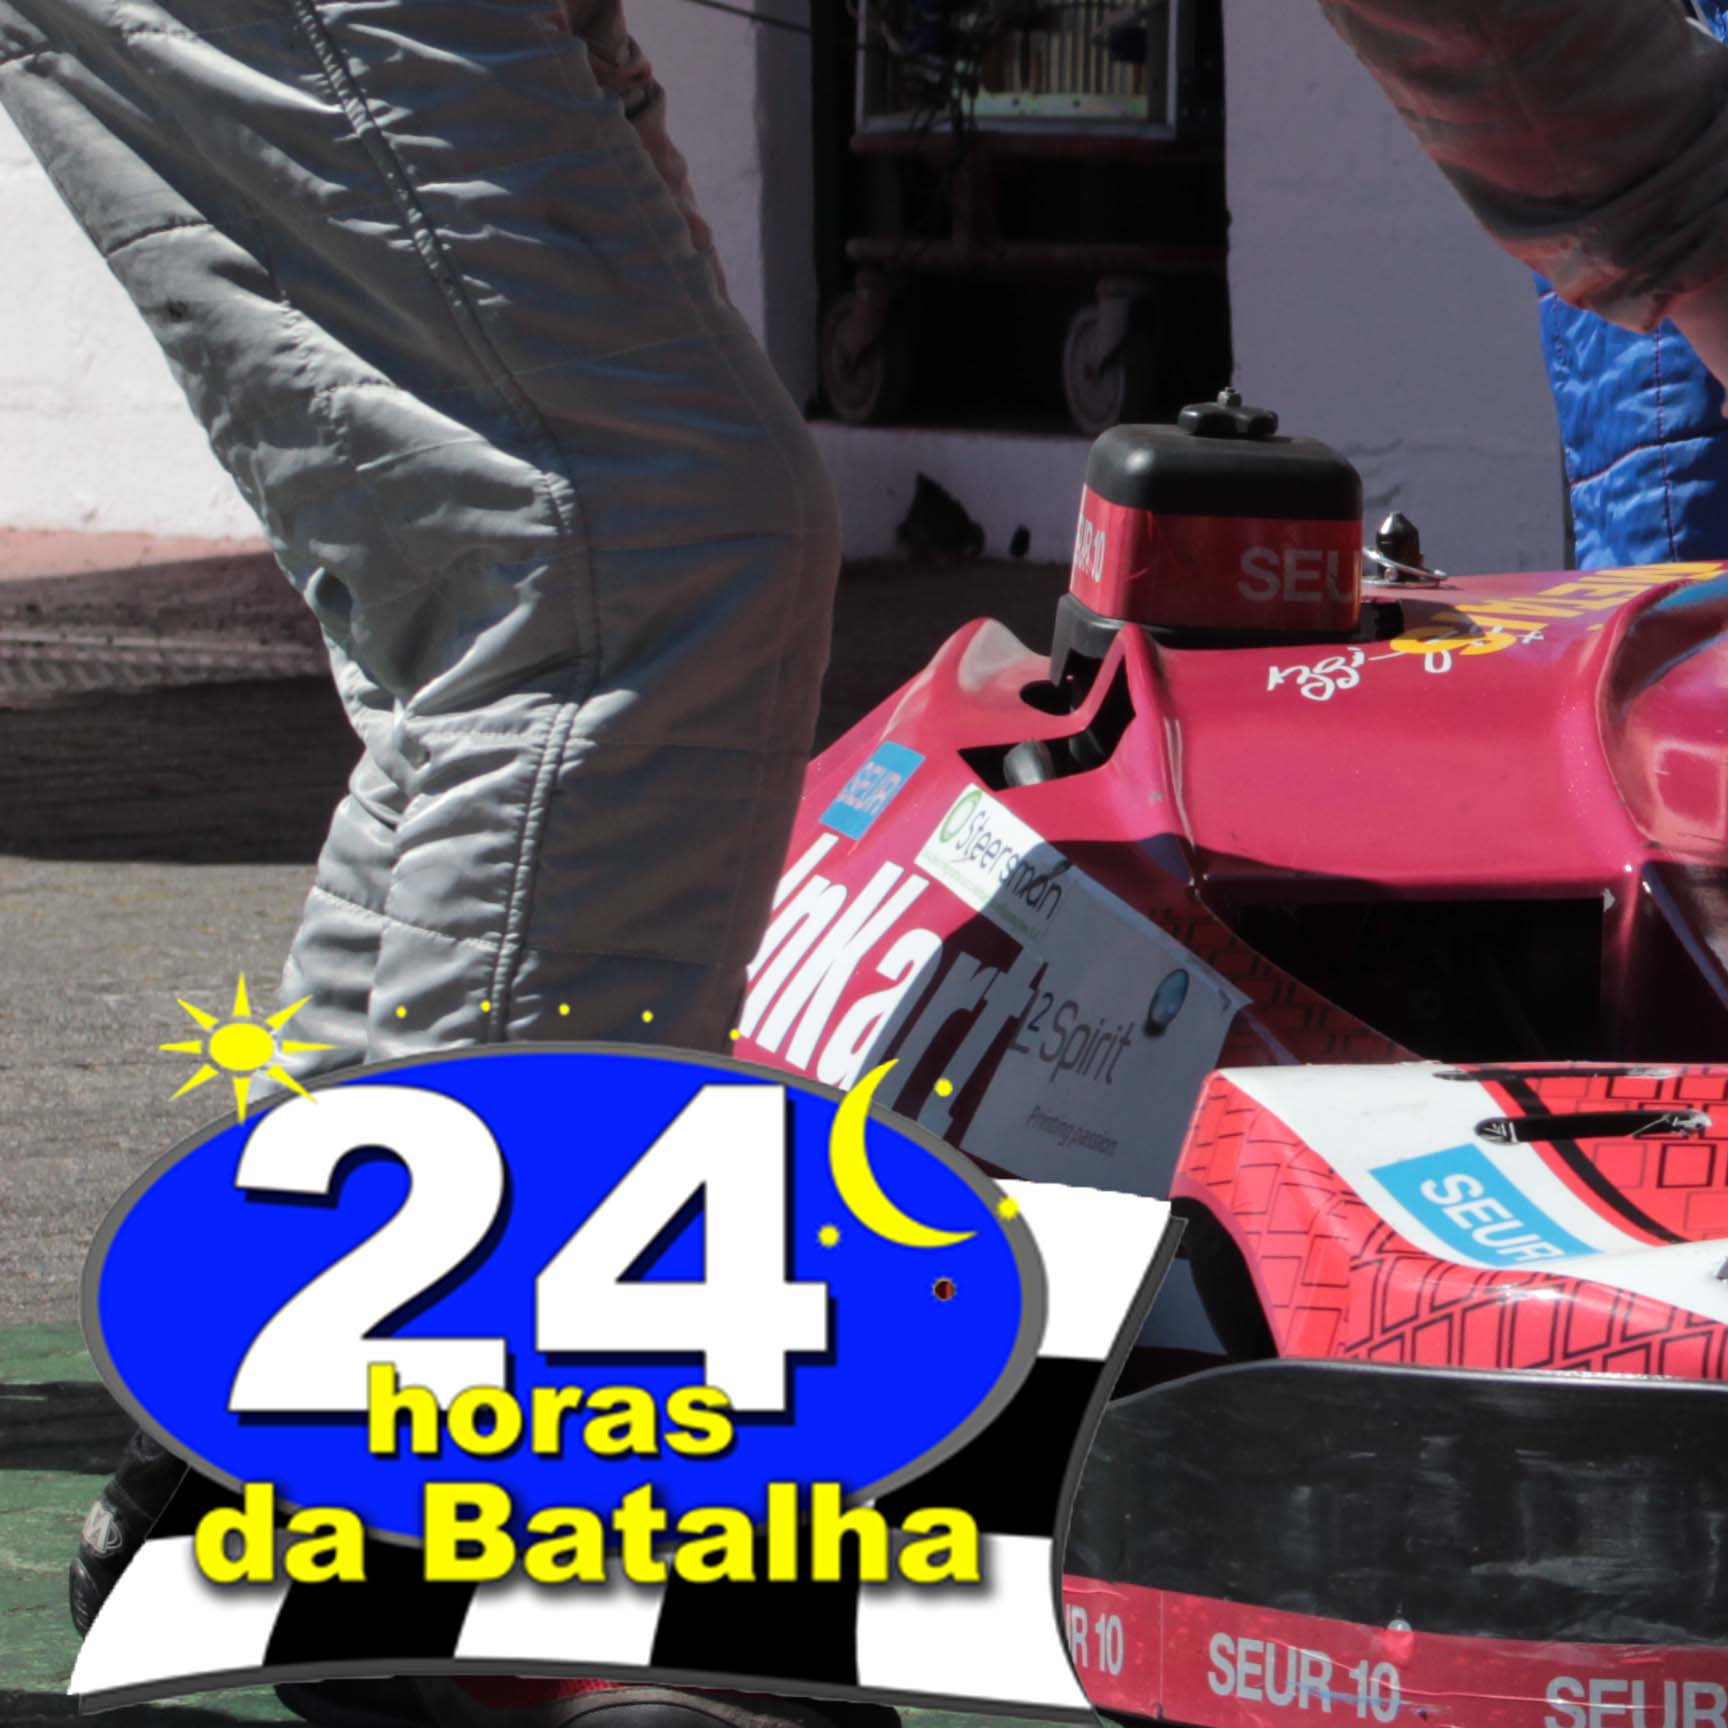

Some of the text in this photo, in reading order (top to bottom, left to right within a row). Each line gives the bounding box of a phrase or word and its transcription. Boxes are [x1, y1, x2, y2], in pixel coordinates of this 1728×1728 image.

[959, 809, 1063, 921] Steersman
[1040, 999, 1136, 1086] Spirit
[1421, 1171, 1562, 1267] SEUR
[1093, 1613, 1124, 1677] 10
[1208, 1632, 1401, 1724] SEUR 10
[1545, 1677, 1728, 1728] SEUR
